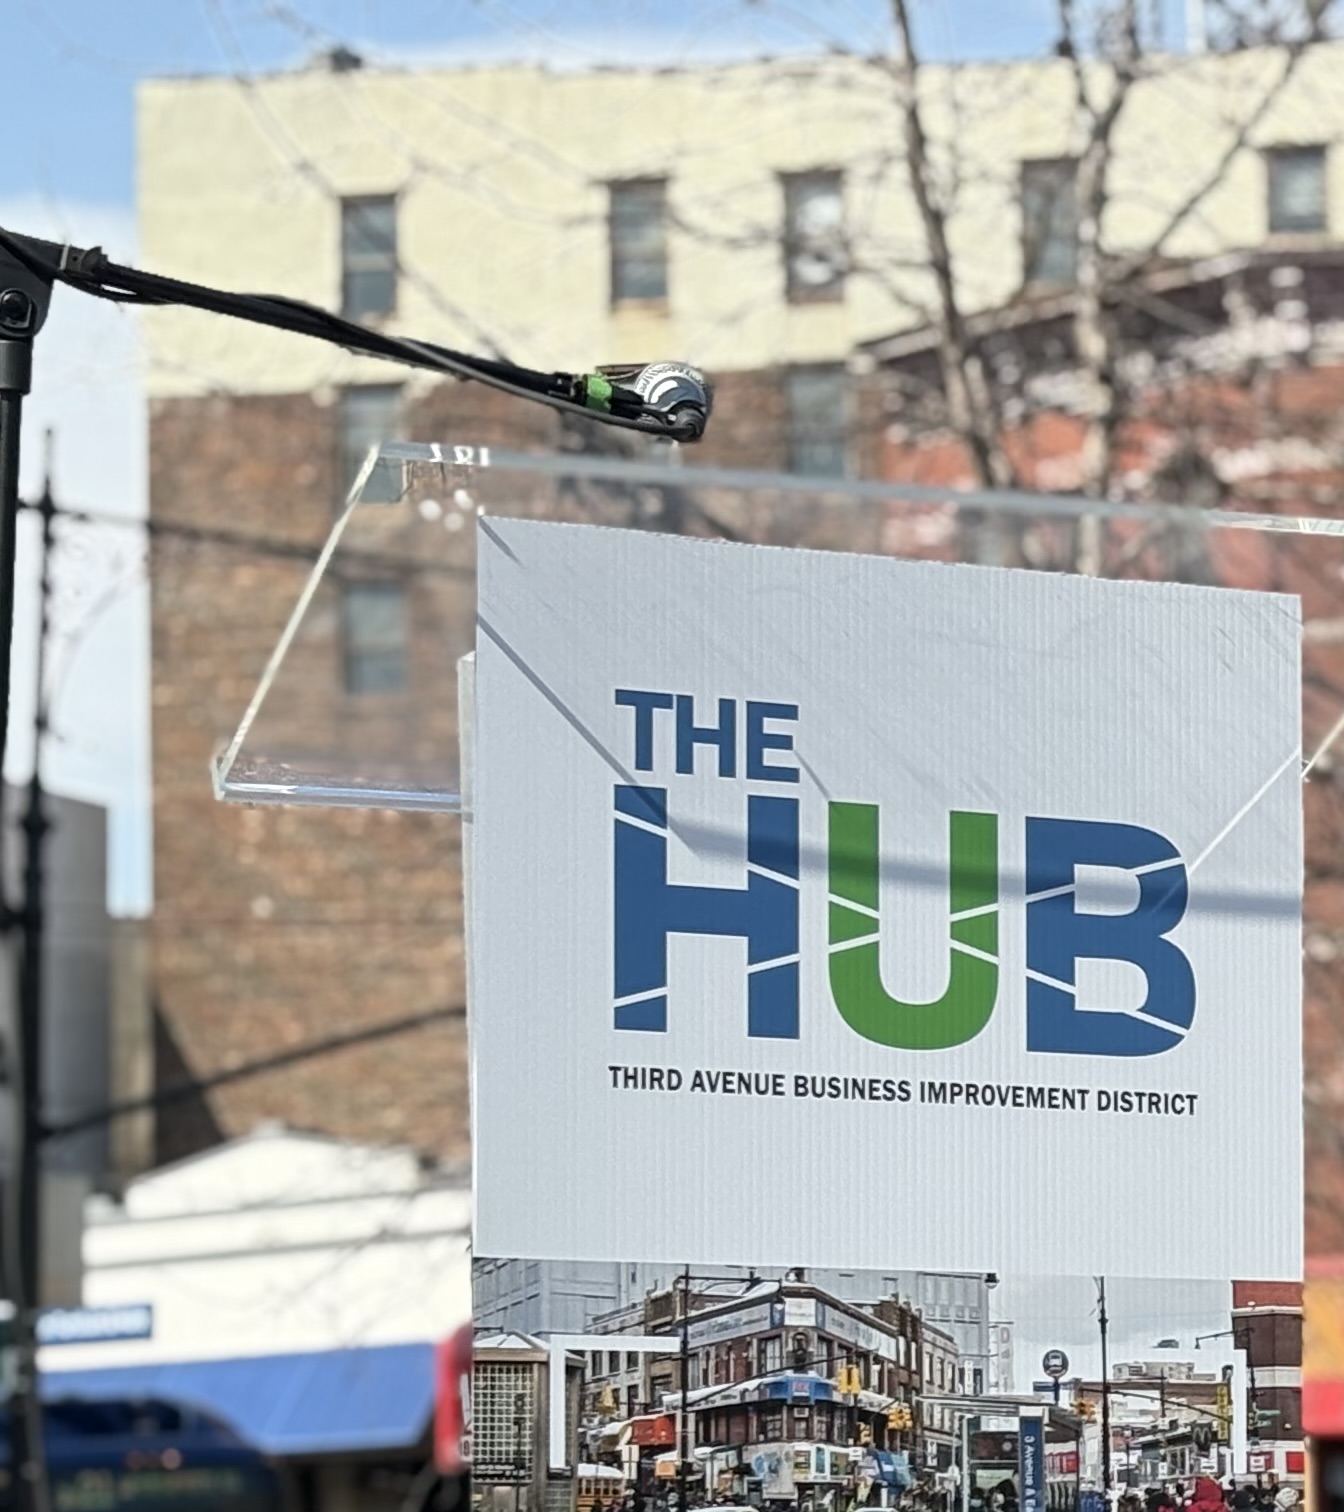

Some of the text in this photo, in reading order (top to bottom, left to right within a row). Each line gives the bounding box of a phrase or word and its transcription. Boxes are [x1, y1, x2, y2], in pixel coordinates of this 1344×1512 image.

[614, 688, 800, 783] THE
[613, 783, 1197, 1057] HUB
[608, 1065, 1198, 1116] THIRD AVENUE BUSINESS IMPROVEMENT DISTRICT
